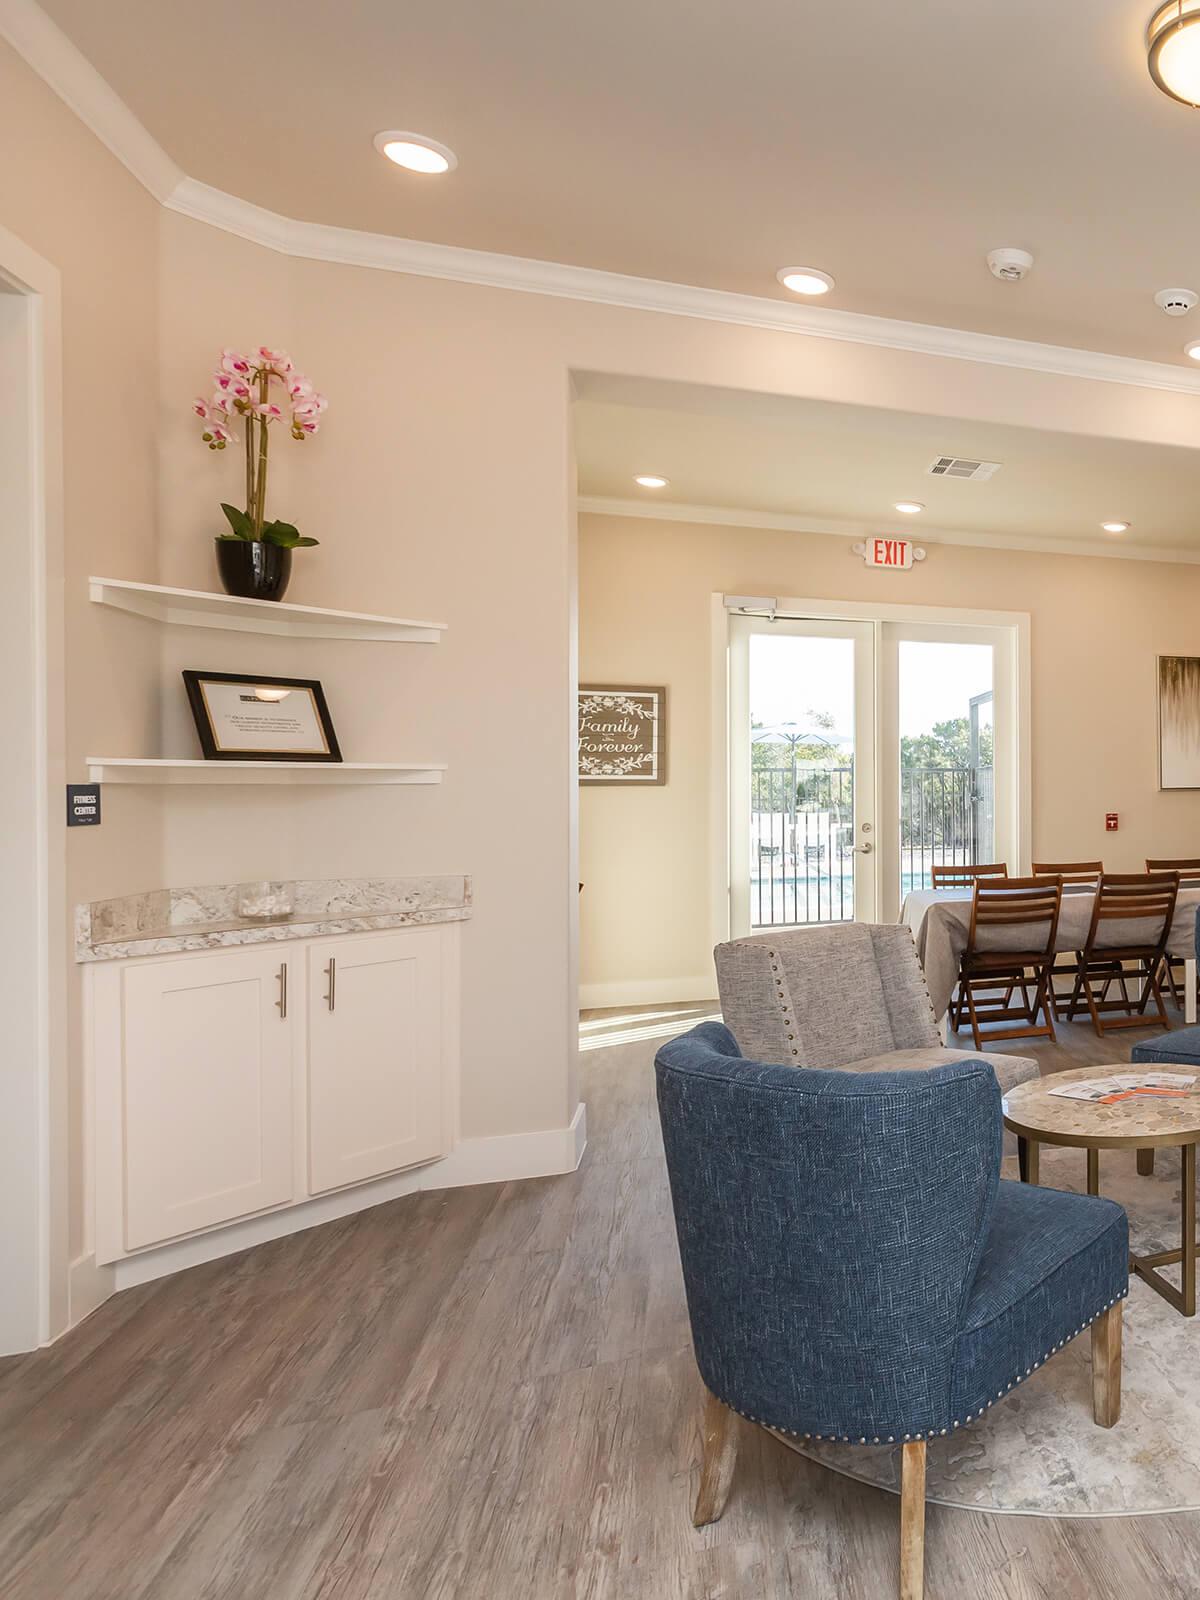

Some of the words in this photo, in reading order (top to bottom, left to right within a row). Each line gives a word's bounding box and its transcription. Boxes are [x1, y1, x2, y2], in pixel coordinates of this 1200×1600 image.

[874, 539, 907, 566] EXIT
[579, 716, 640, 740] Family
[74, 795, 96, 803] FITNESS
[74, 806, 96, 815] CENTER
